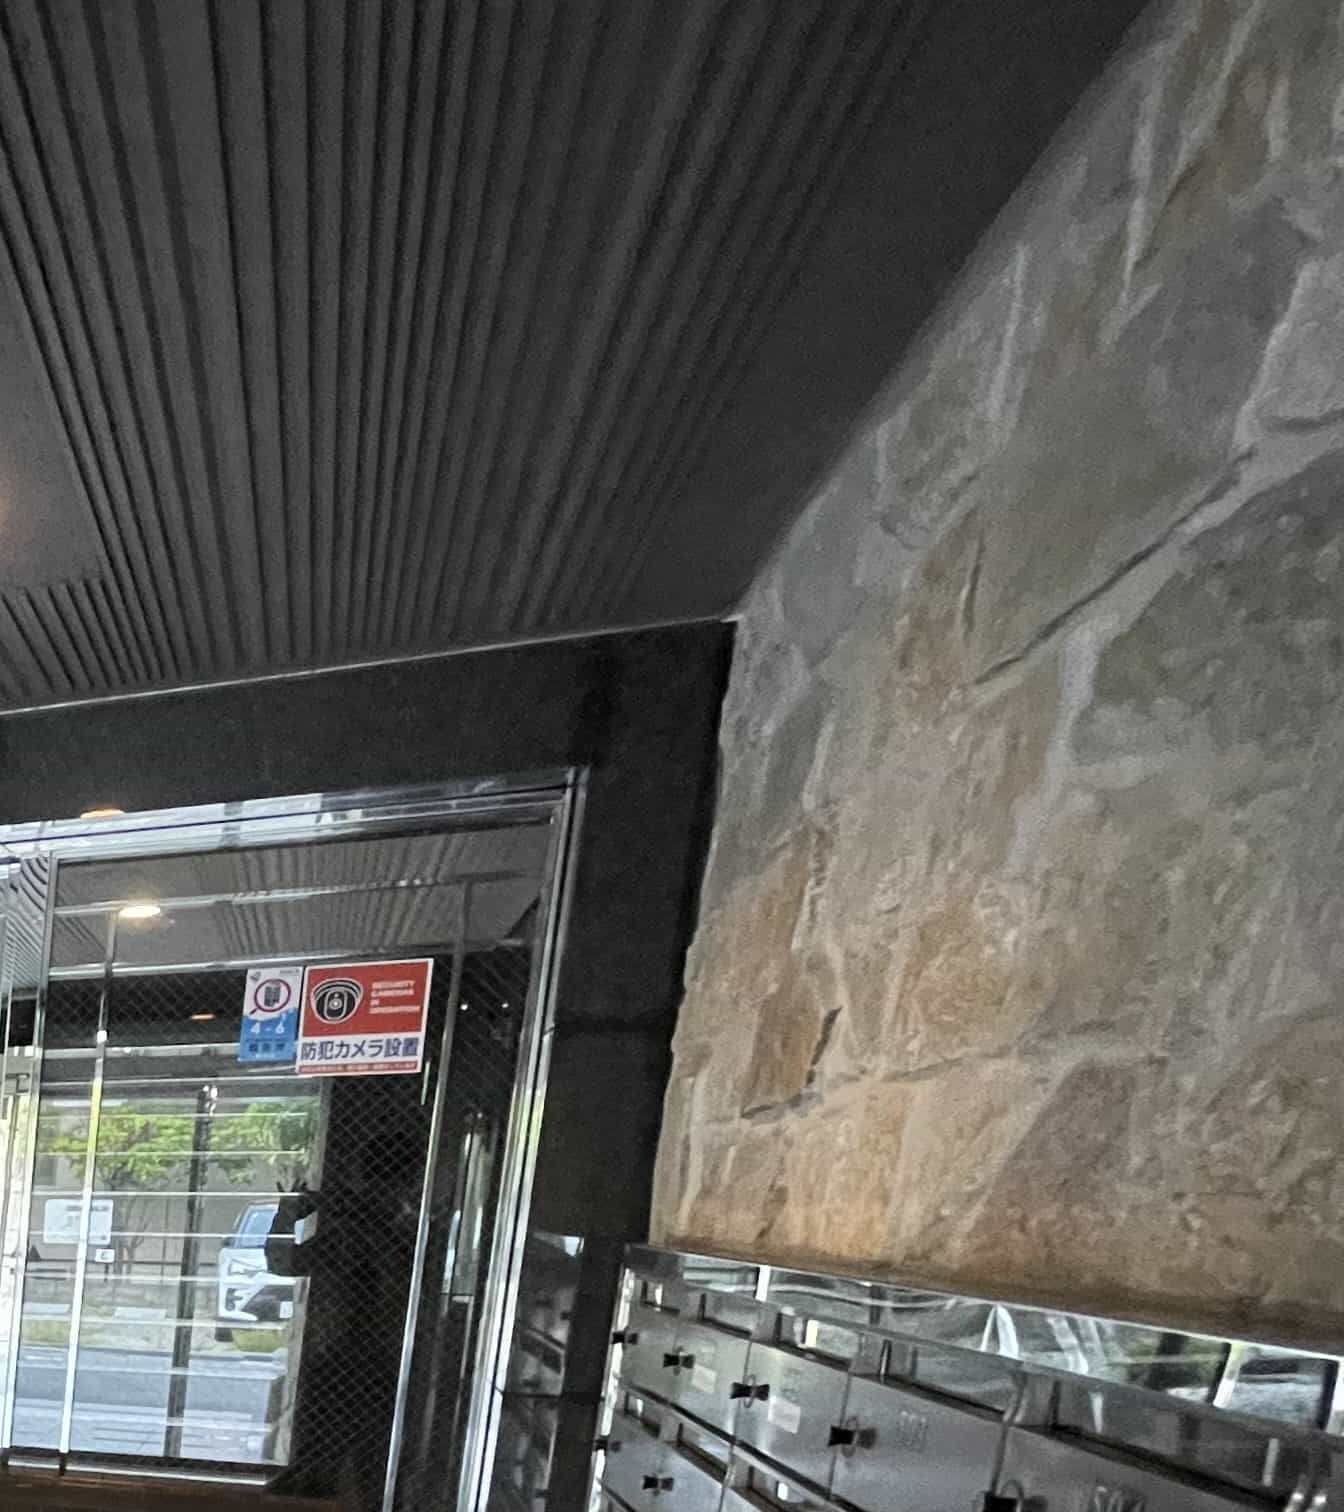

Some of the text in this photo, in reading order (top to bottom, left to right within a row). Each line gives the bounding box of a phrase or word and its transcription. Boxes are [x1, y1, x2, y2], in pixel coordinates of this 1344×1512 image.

[300, 1037, 420, 1061] 防犯カメラ設置
